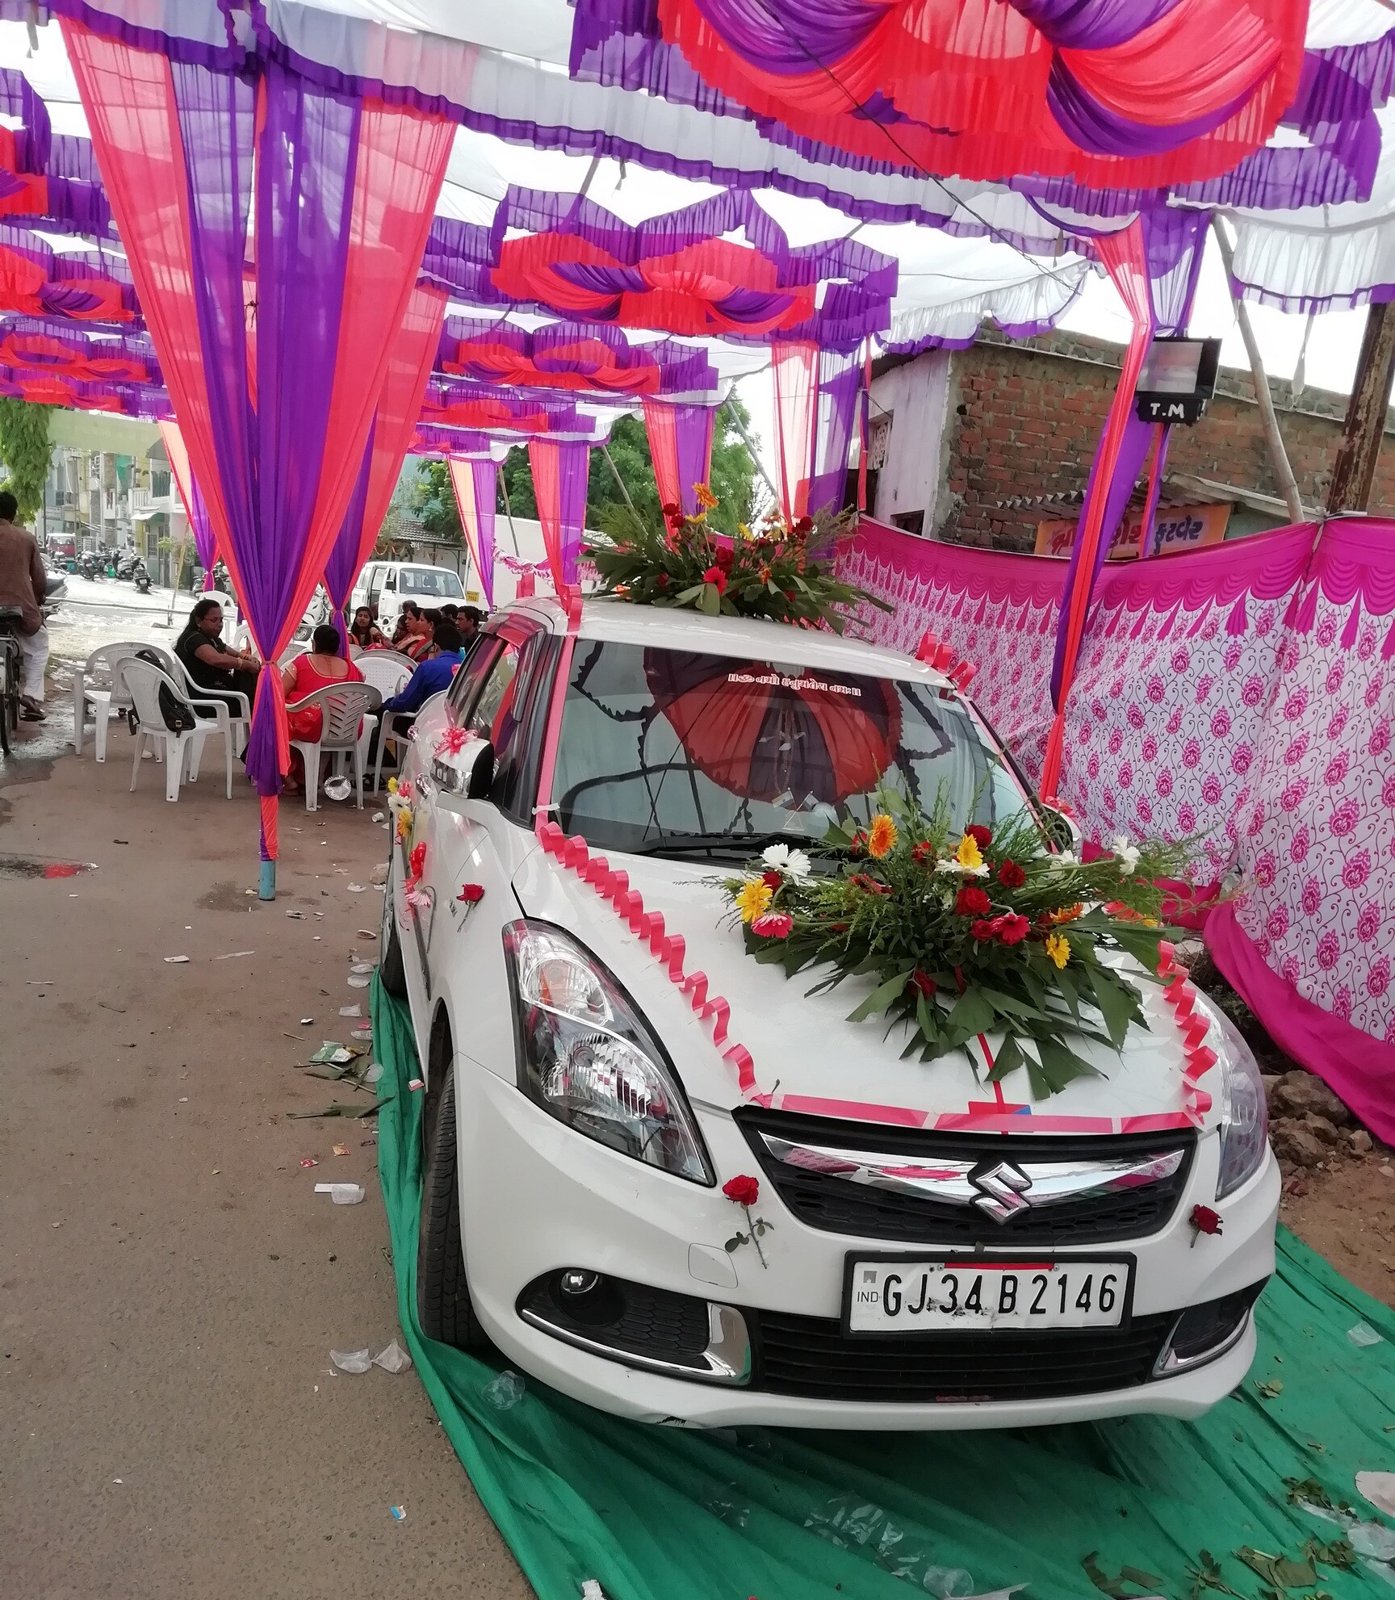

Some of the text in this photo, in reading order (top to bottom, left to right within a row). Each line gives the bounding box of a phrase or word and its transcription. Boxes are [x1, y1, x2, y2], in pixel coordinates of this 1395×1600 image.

[1150, 402, 1185, 419] T.M
[857, 1291, 879, 1303] IND
[998, 1274, 1018, 1314] B
[1029, 1273, 1117, 1314] 2146
